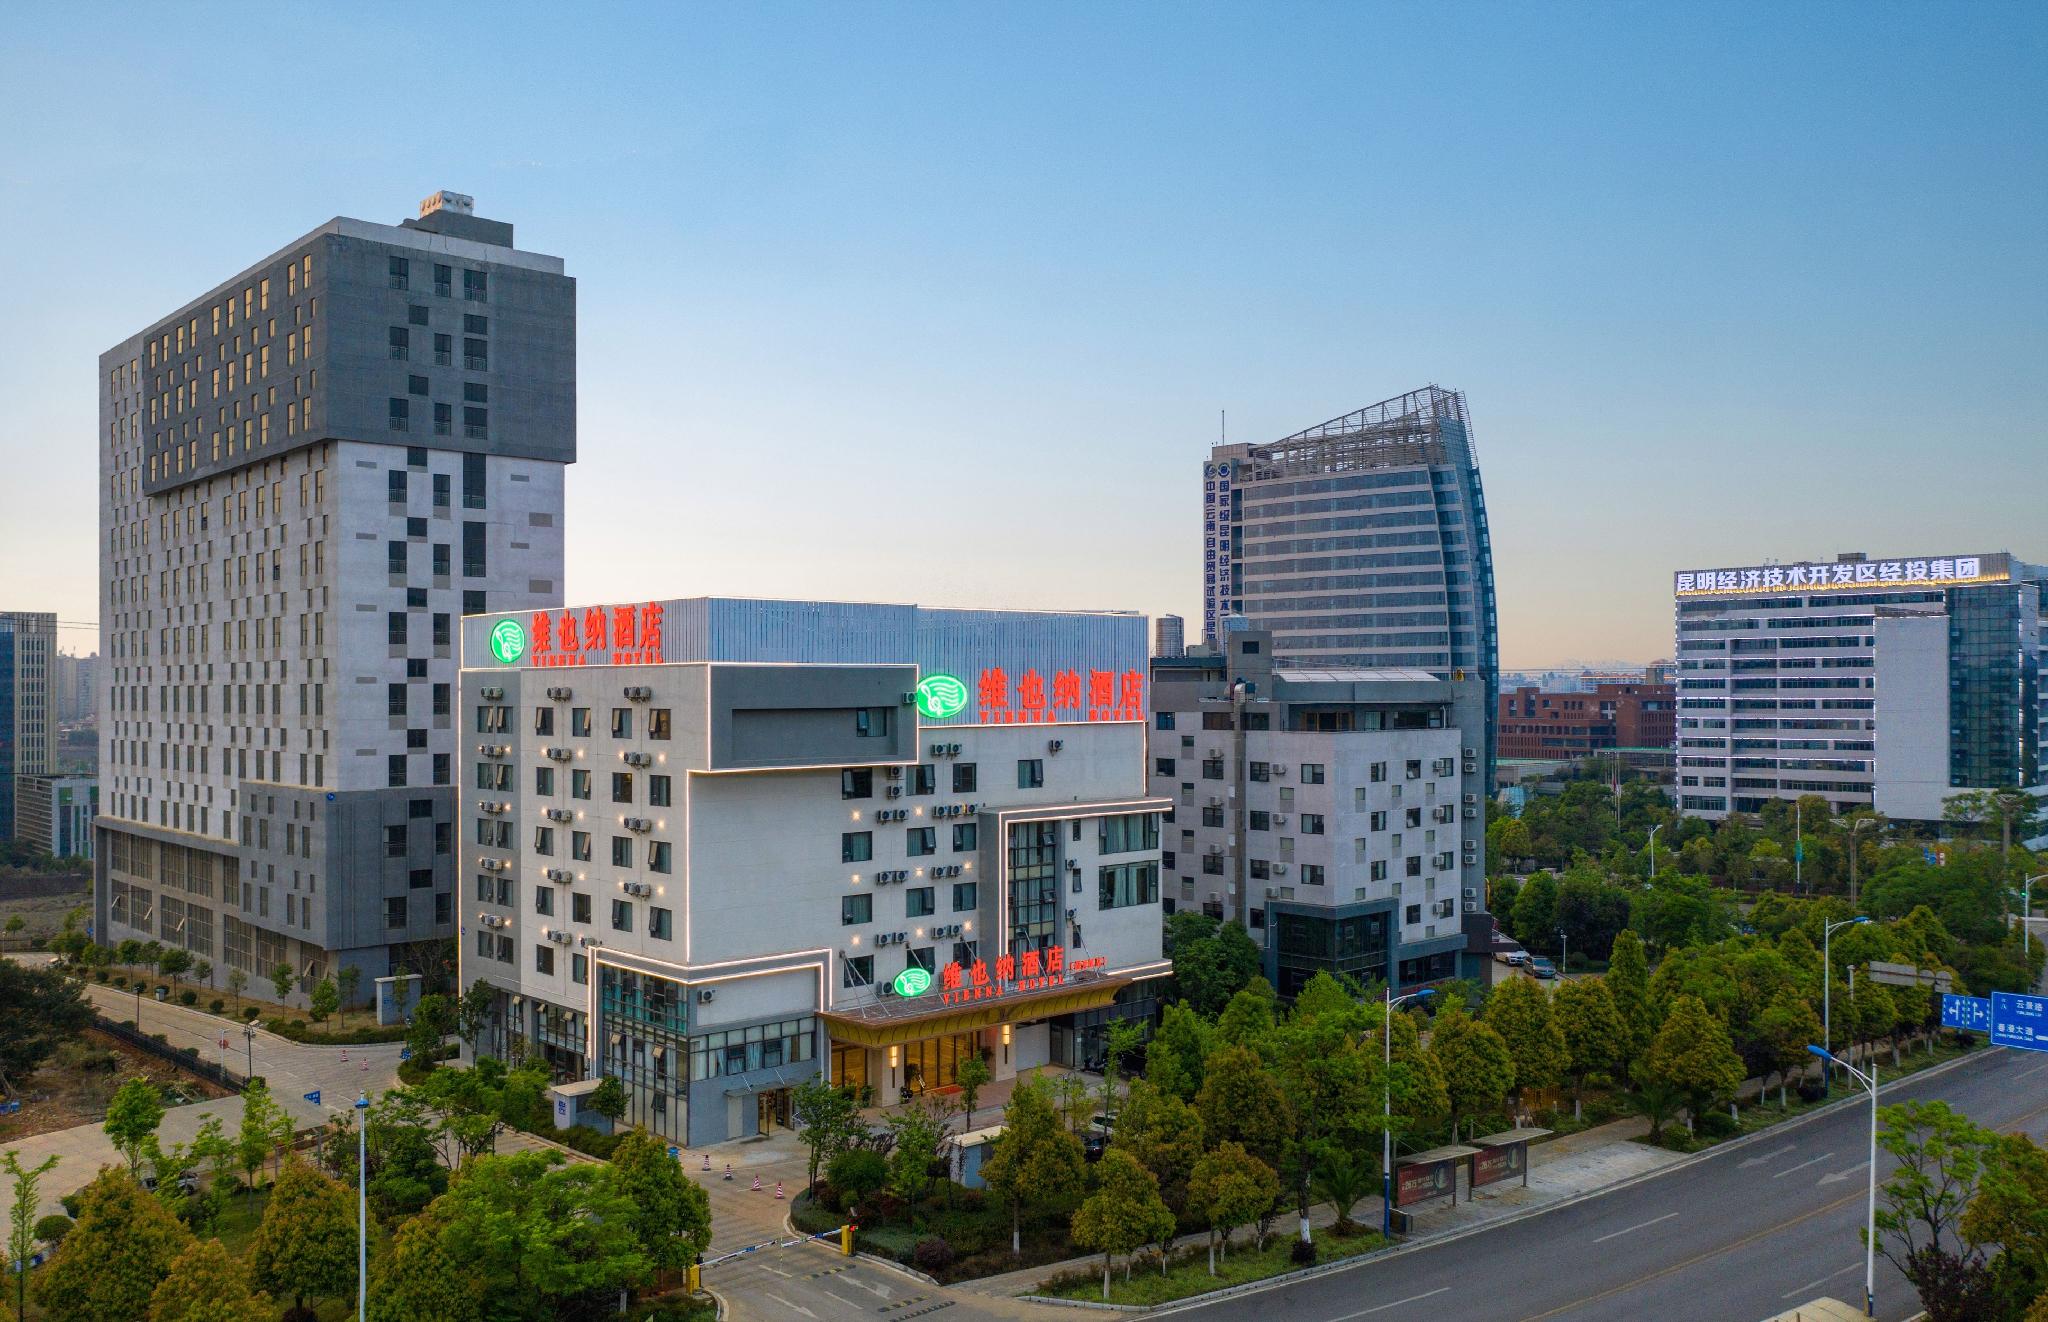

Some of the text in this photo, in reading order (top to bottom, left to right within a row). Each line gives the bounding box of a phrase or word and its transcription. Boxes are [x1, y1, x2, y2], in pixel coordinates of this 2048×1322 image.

[1219, 480, 1230, 616] 国家级昆明经济技术
[1676, 557, 1980, 592] 昆明经济技术开发区经投集团
[531, 601, 664, 653] 维也纳酒店
[978, 667, 1144, 710] 维也纳酒店
[942, 944, 1065, 990] 维也纳酒店
[943, 973, 1065, 1006] VIENNA HOTEL
